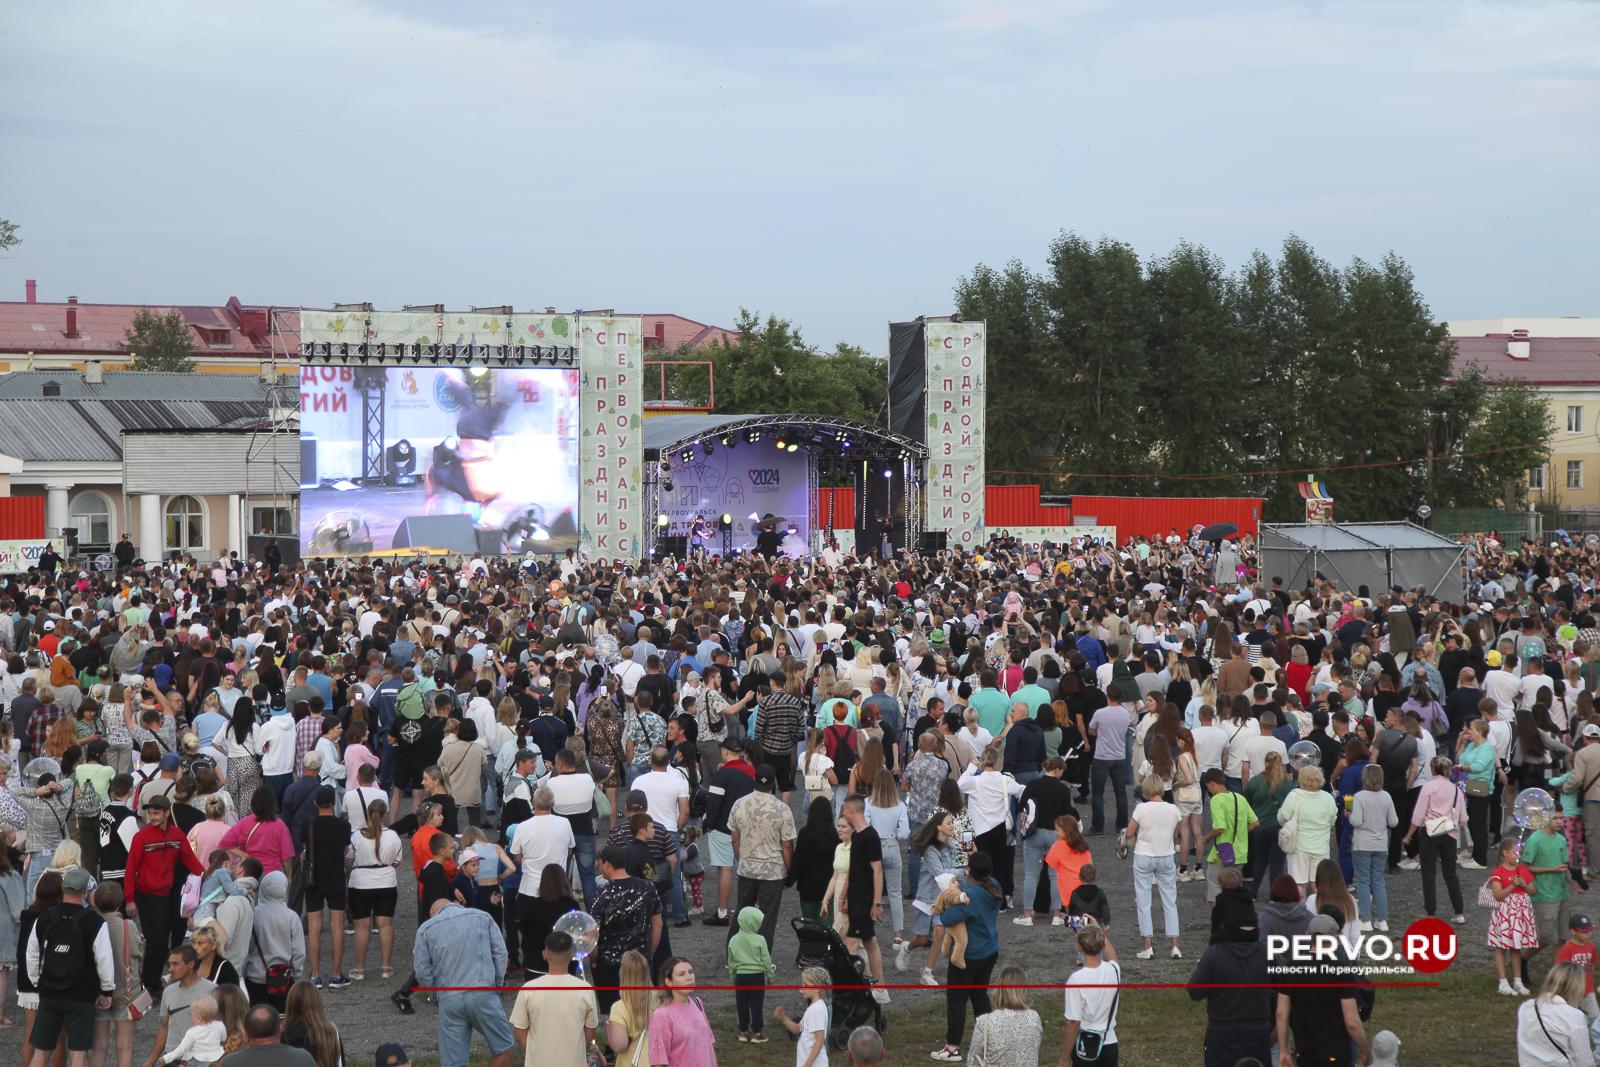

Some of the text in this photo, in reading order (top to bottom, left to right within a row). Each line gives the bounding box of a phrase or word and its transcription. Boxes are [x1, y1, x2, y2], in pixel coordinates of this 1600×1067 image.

[961, 336, 972, 554] РОДНОЙ ГОРО
[753, 469, 780, 485] 2024
[752, 486, 763, 494] ГОД
